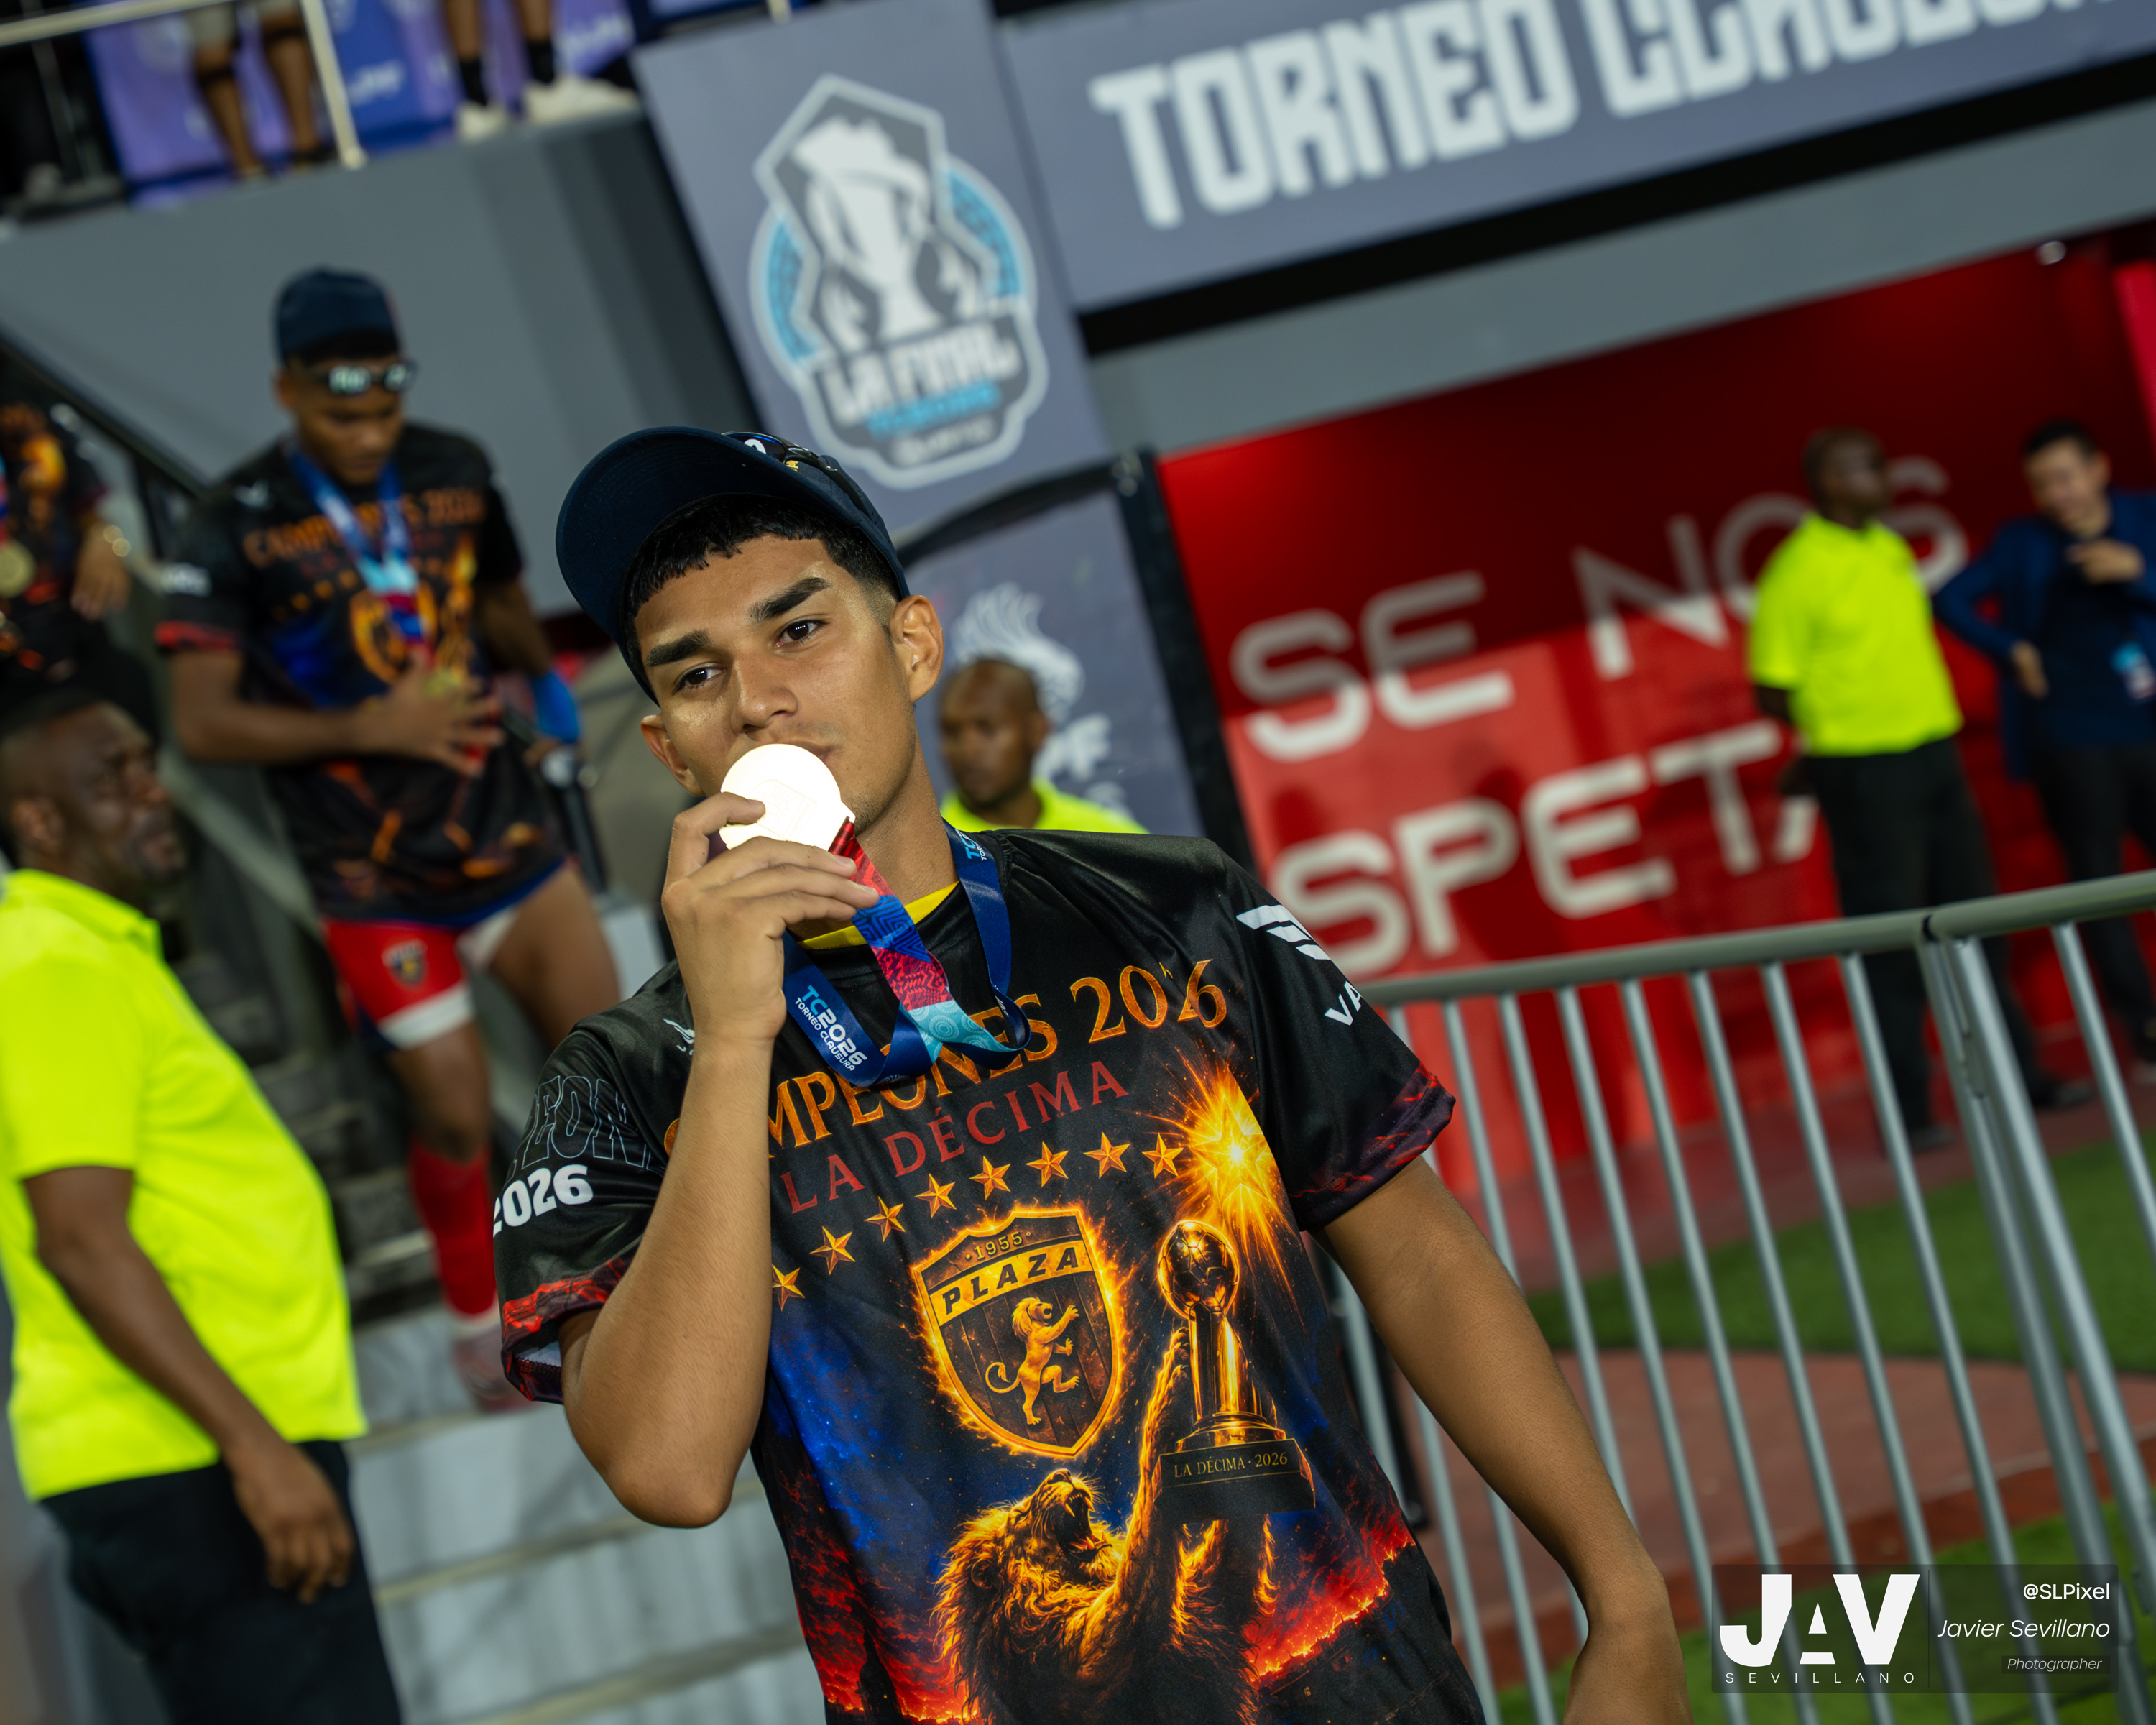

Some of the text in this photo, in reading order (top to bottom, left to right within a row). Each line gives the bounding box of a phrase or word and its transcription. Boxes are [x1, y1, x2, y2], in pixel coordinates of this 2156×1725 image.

[1088, 0, 1580, 229] TORNEO
[1230, 571, 1514, 763] SE
[795, 997, 856, 1072] TORNEO CLAUSURA
[801, 984, 868, 1066] TC2026
[780, 1060, 1130, 1214] LA DÉCIMA
[941, 1246, 1079, 1315] PLAZA
[974, 1231, 1023, 1259] 1955
[1174, 1452, 1288, 1478] LA DÉCIMA 2026
